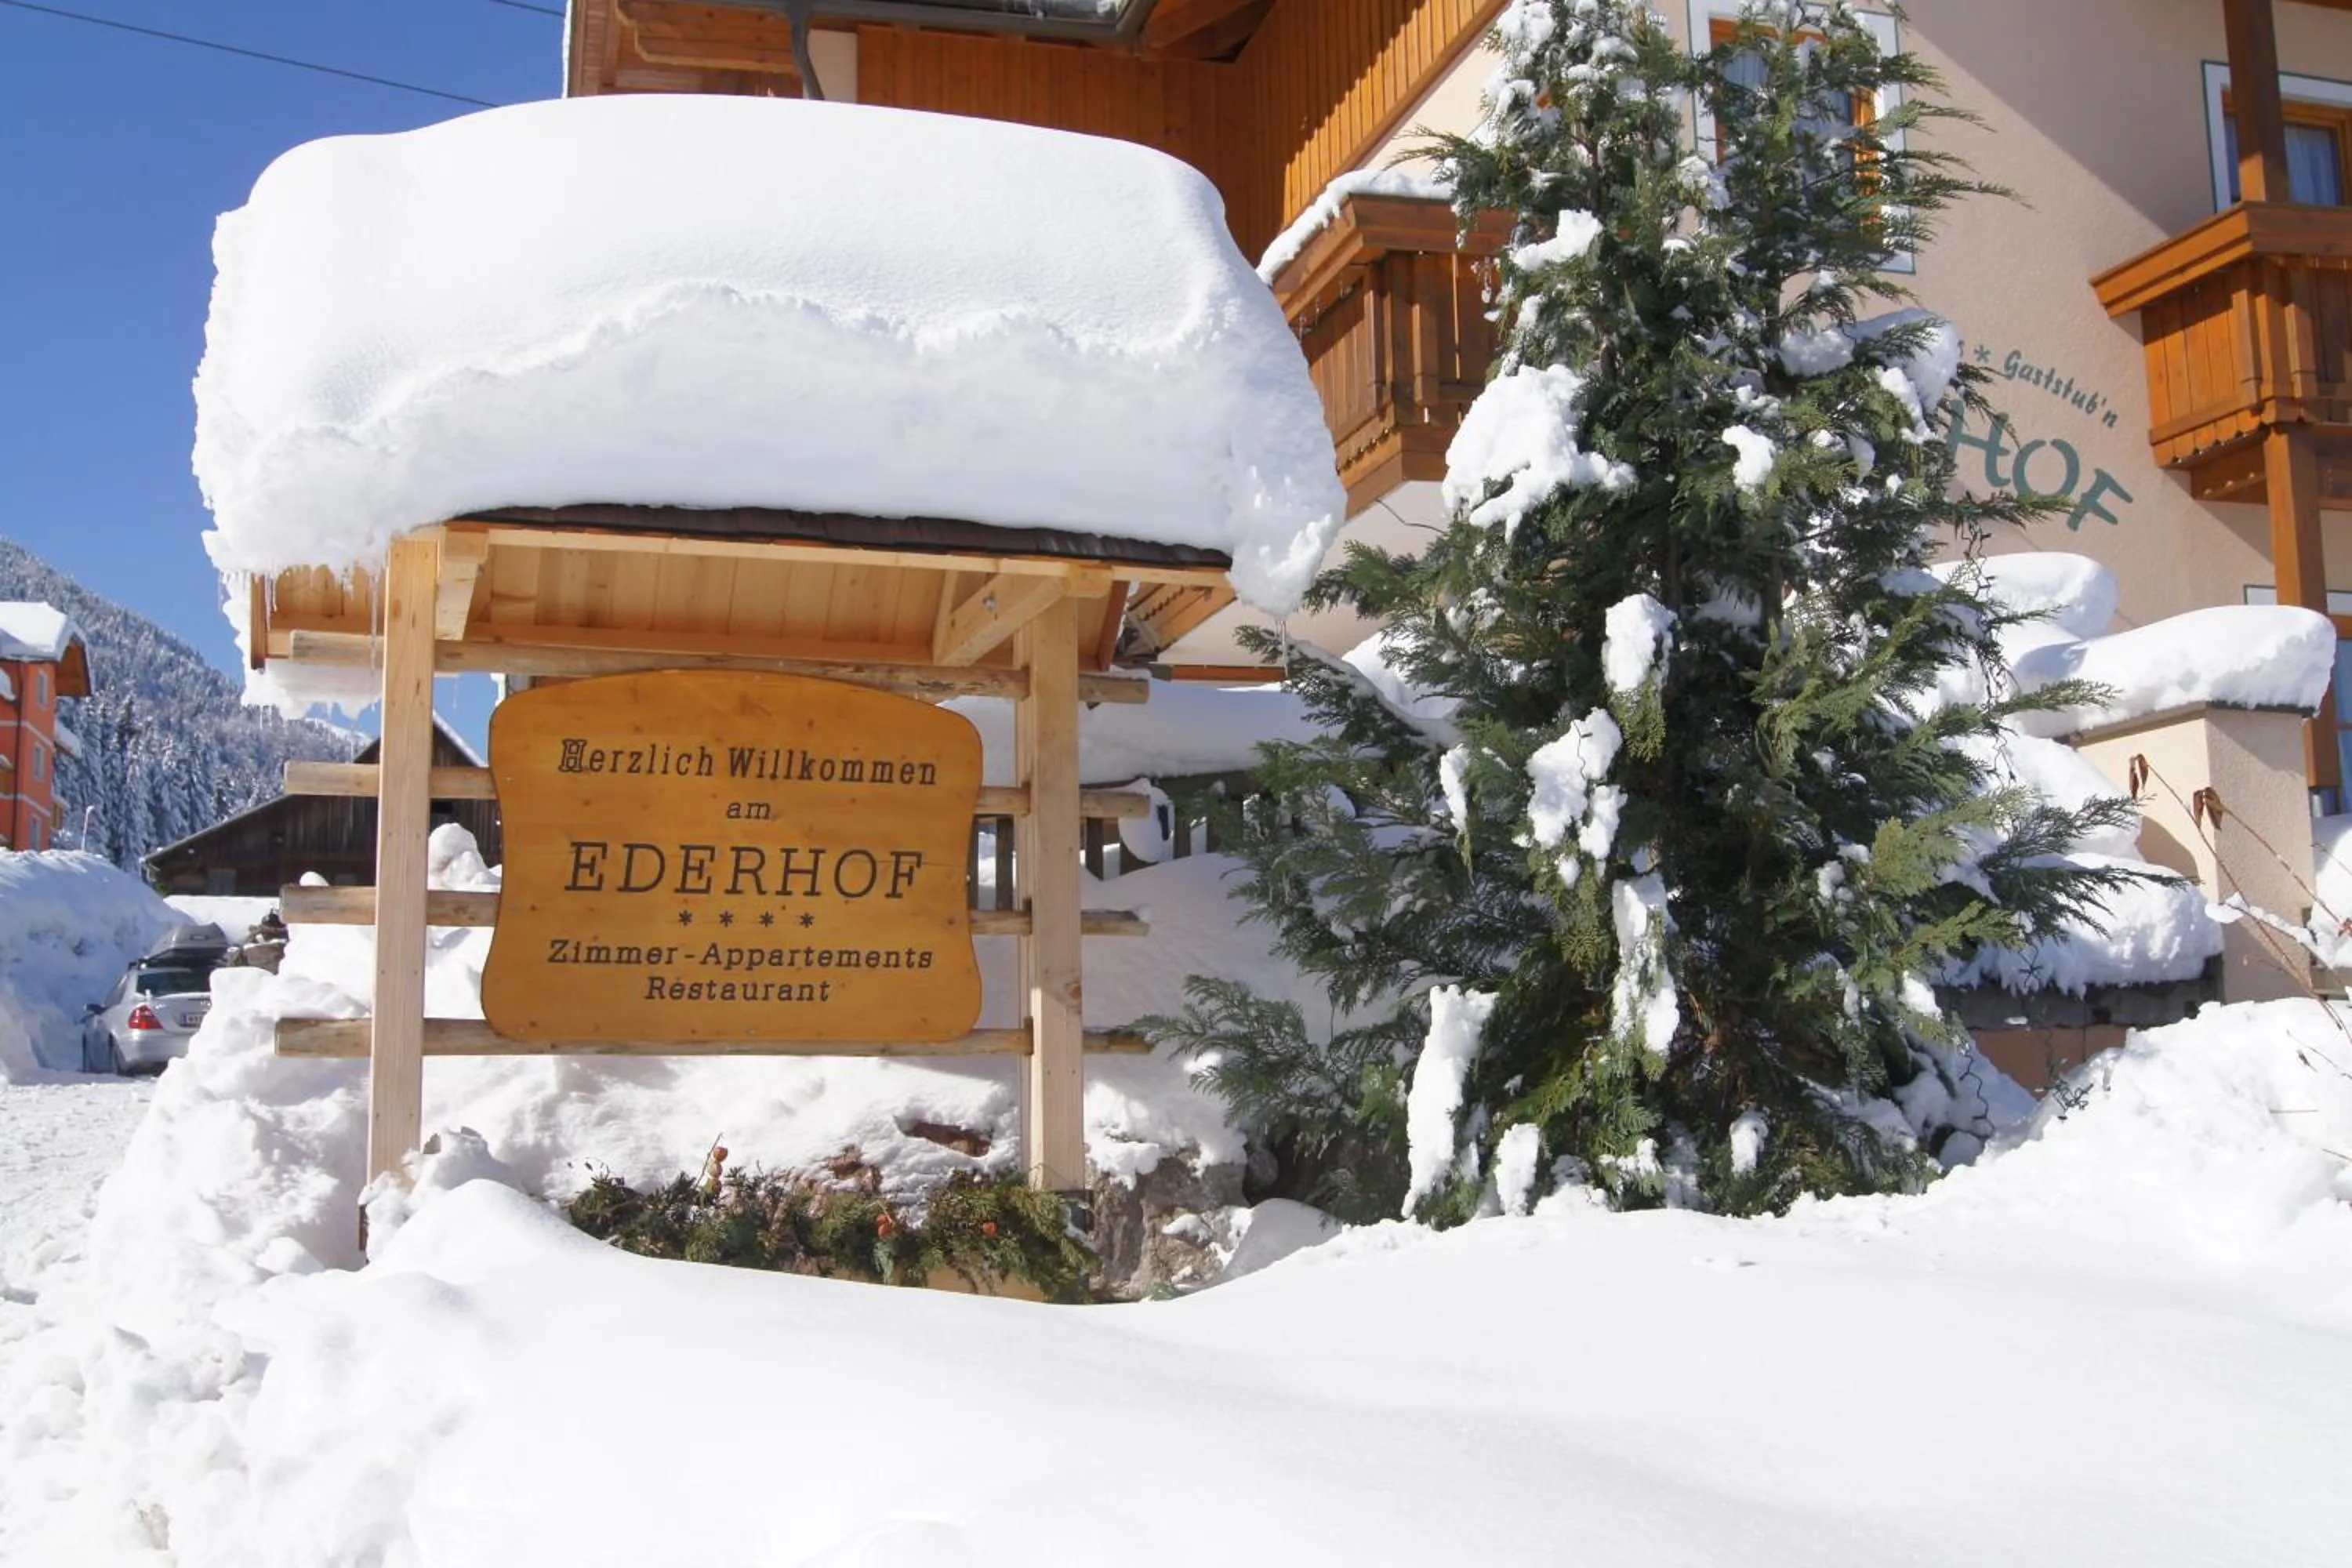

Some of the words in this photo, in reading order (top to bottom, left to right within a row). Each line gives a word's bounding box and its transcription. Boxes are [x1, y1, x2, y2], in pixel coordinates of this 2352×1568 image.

[2003, 349, 2118, 428] Gaststub'n
[557, 738, 713, 775] Herzlich
[728, 746, 936, 785] Willkommen
[727, 801, 771, 820] am
[564, 840, 925, 899] EDERHOF
[546, 938, 933, 971] Zimmer-Appartements
[644, 975, 830, 1002] Restaurant
